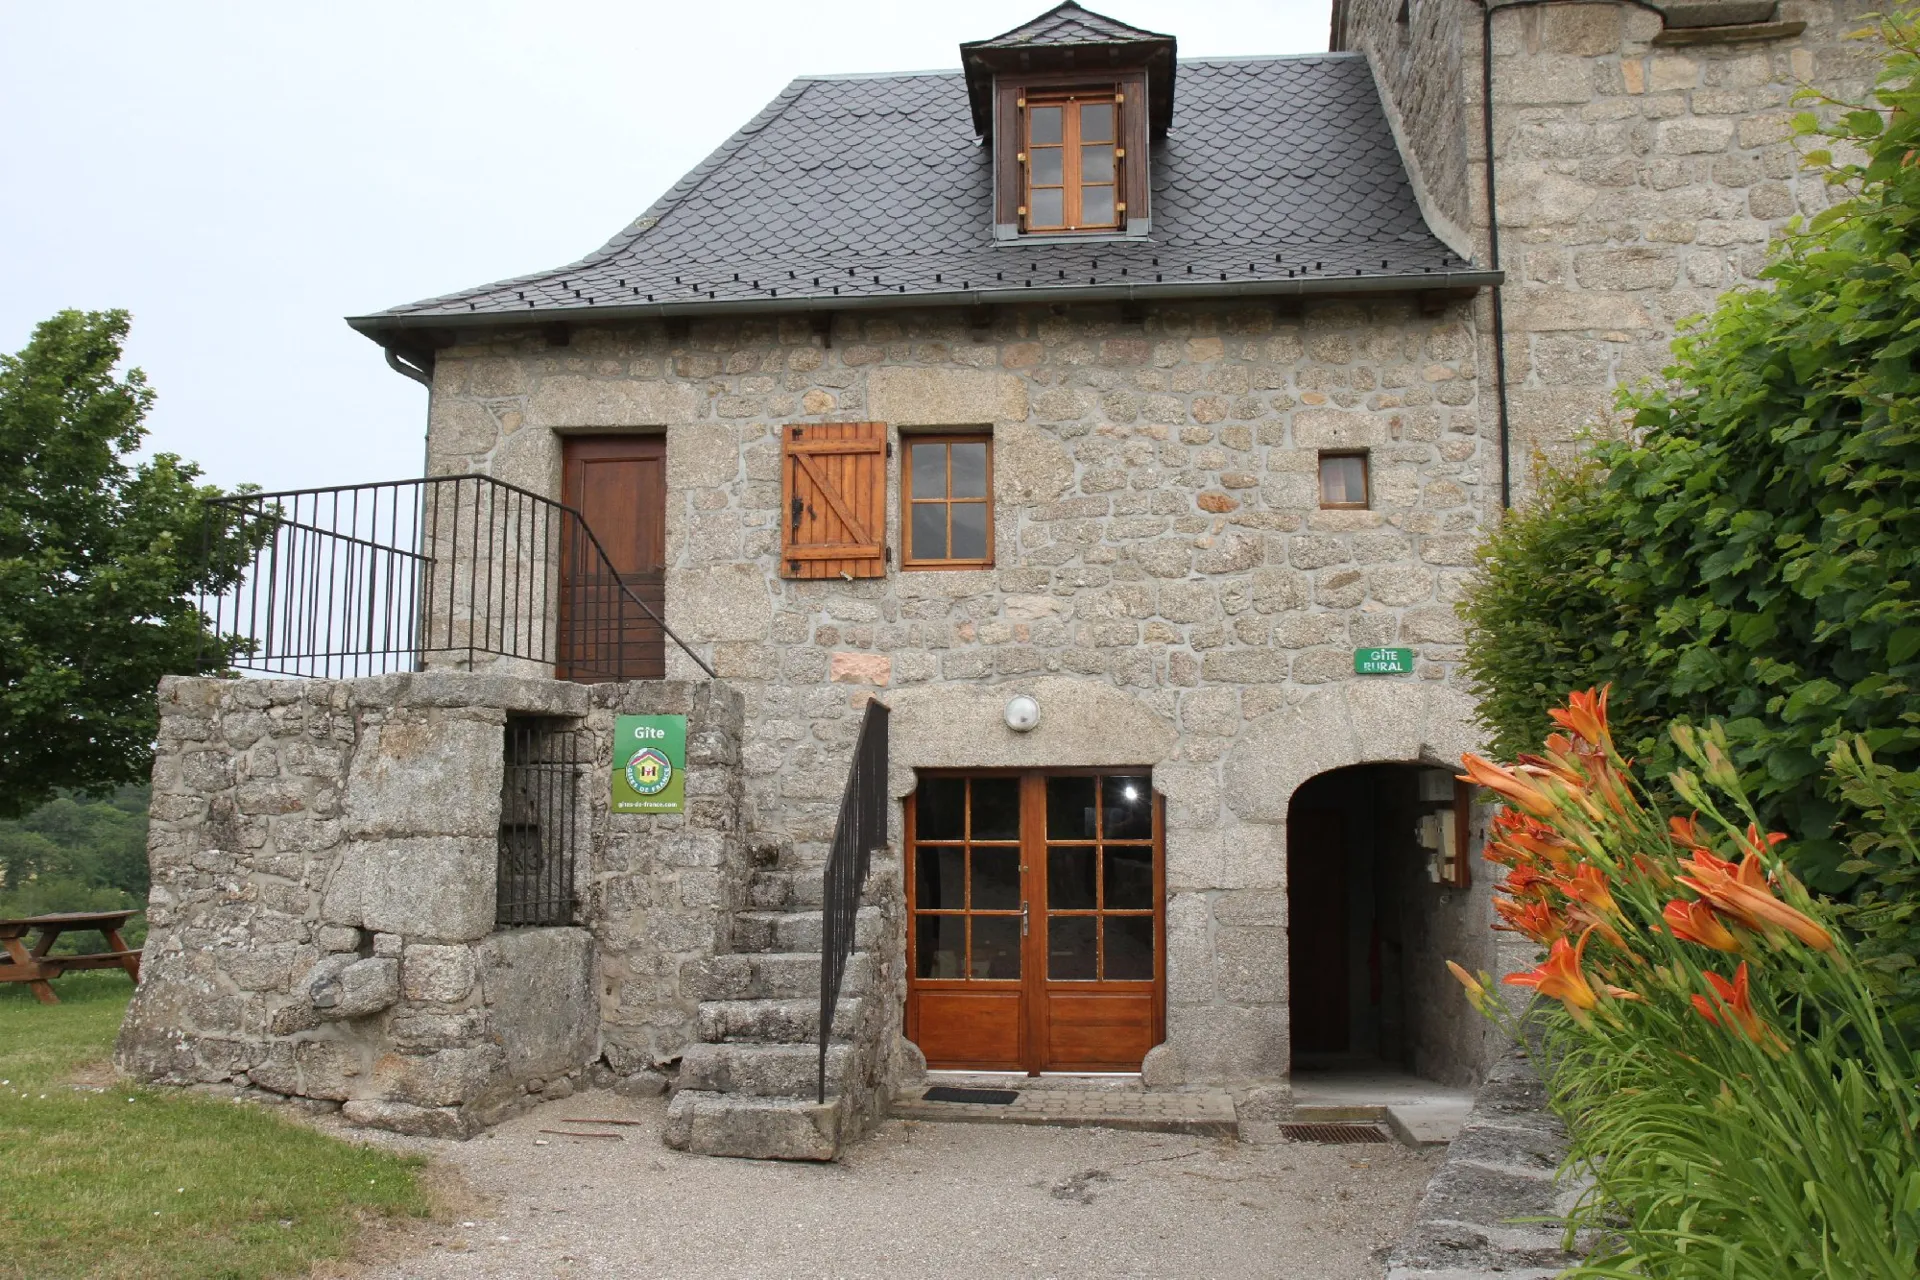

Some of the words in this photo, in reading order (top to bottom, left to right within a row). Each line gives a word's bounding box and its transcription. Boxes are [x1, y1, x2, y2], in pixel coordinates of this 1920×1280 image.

[1363, 662, 1403, 671] RURAL
[634, 726, 665, 739] Gîte
[652, 767, 670, 792] FRANCE
